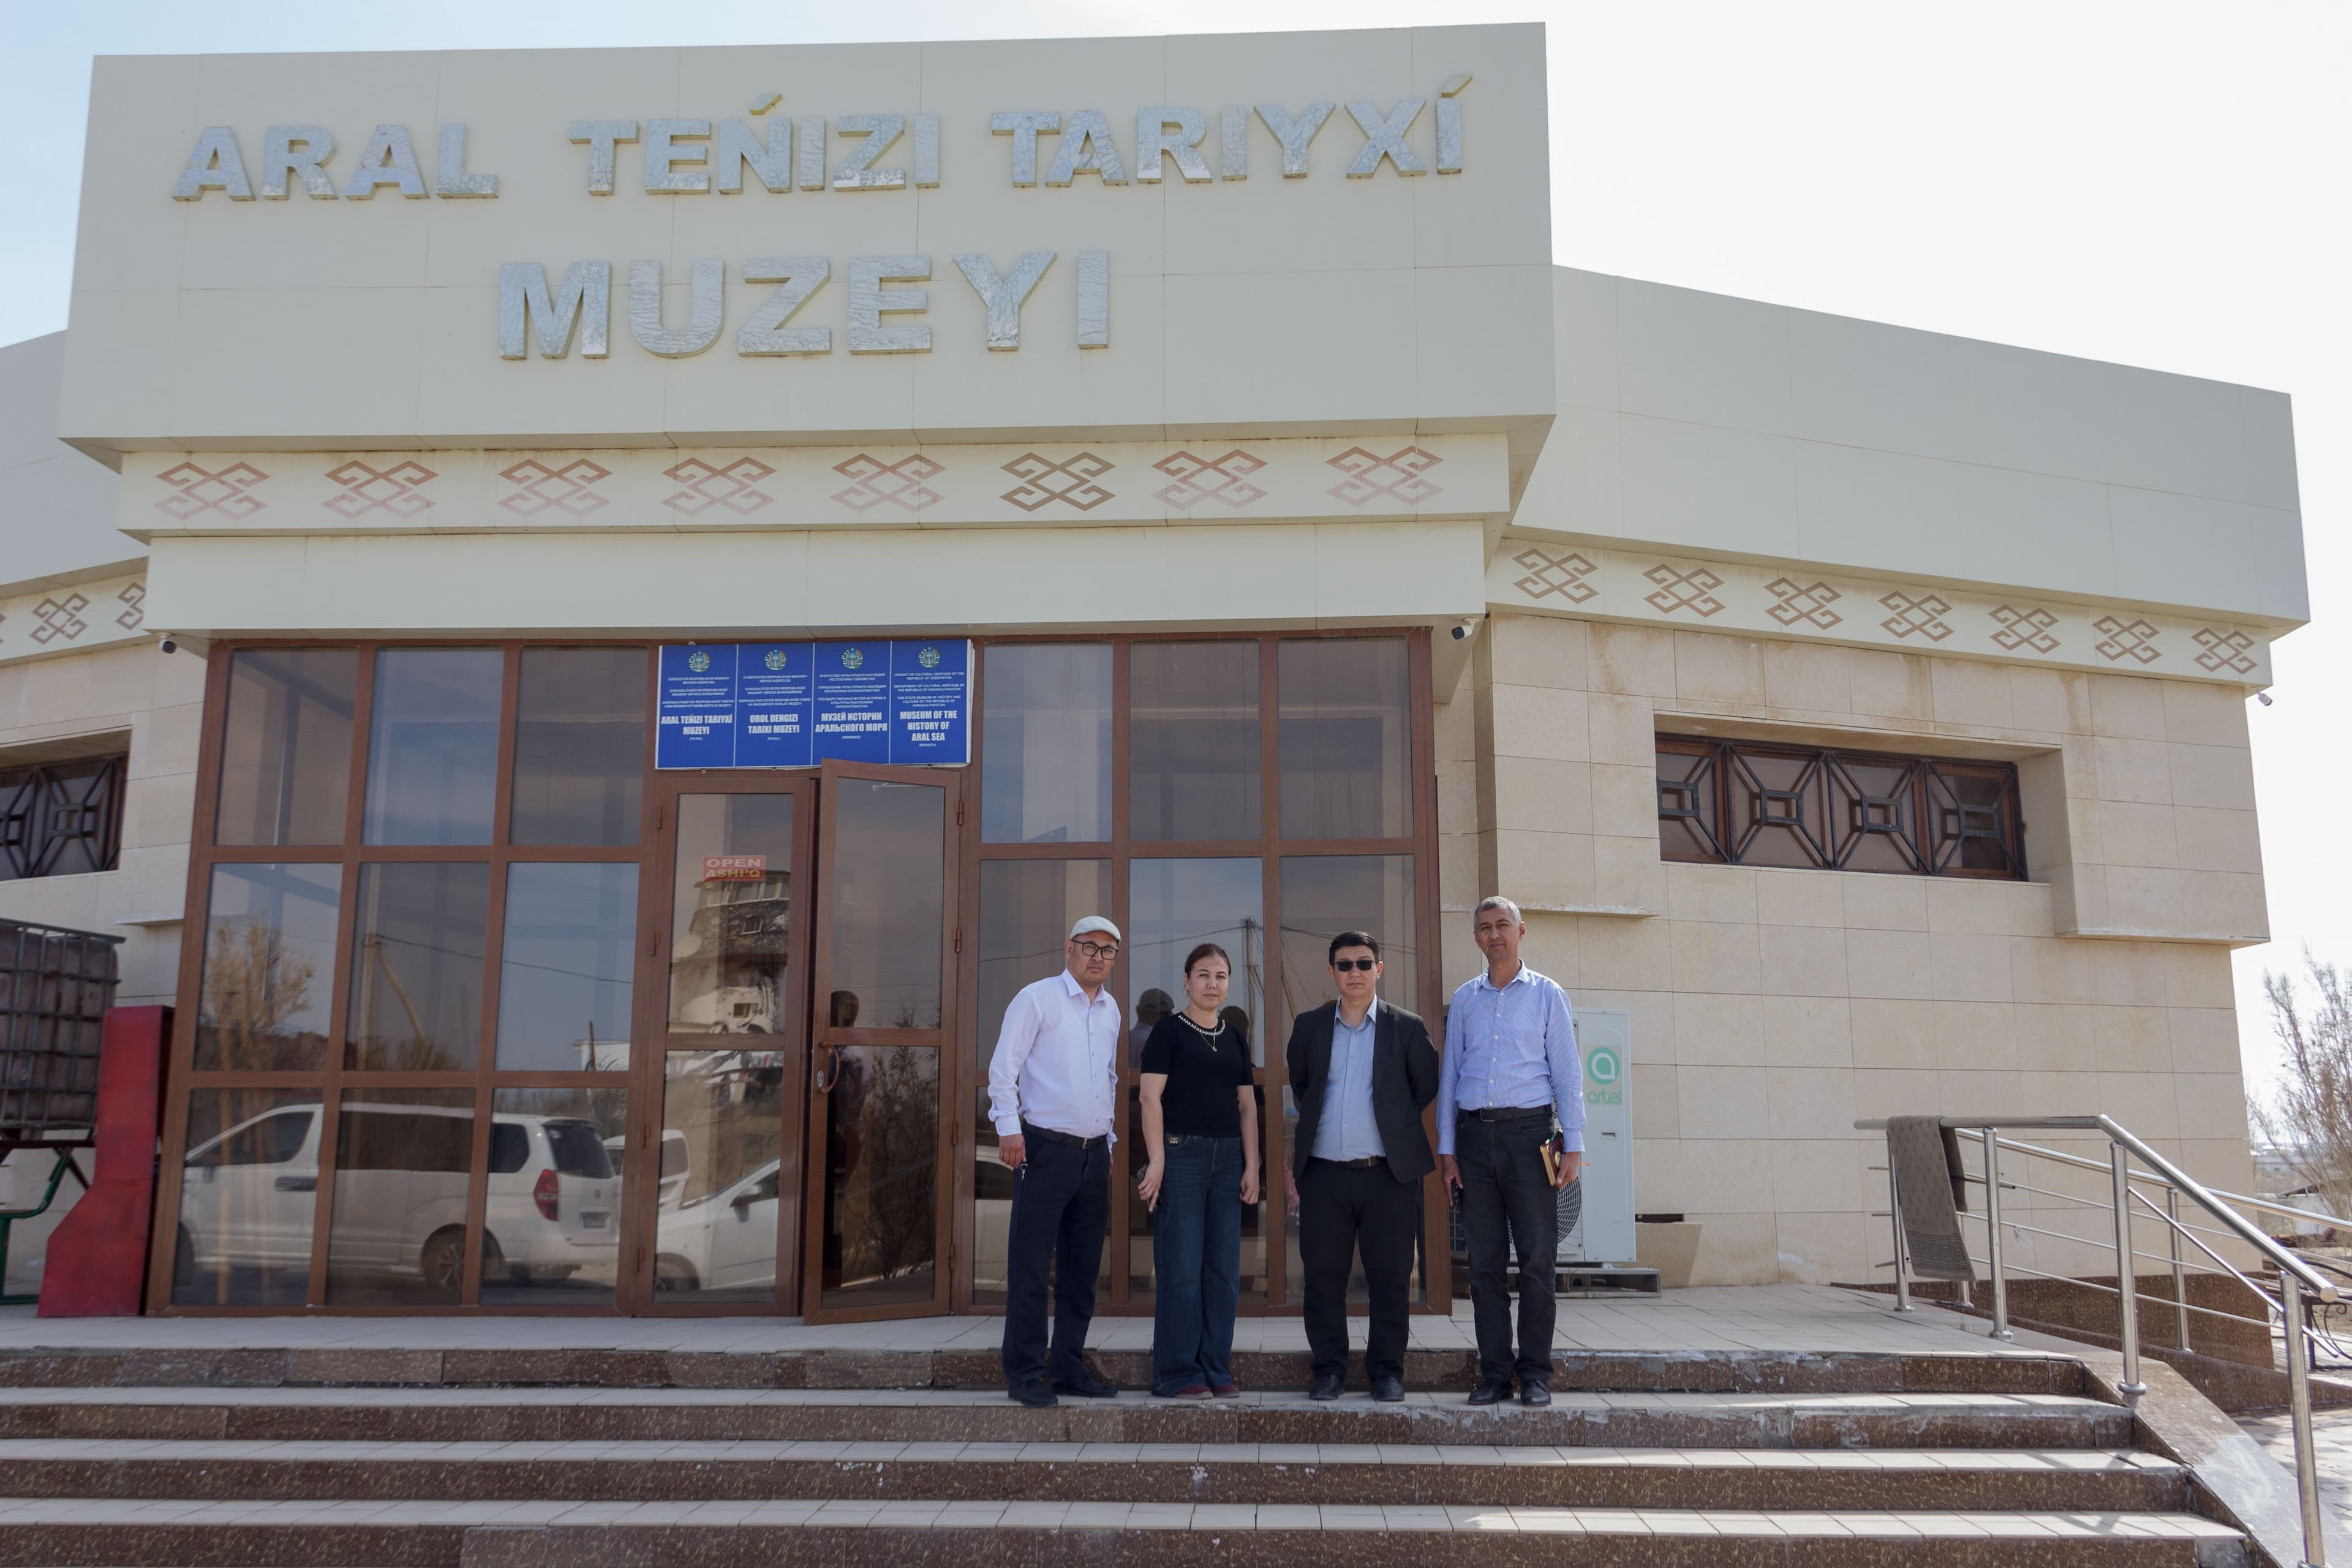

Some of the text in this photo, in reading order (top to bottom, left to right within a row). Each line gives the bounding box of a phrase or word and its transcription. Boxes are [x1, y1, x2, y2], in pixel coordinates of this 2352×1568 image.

[172, 74, 1473, 202] ARAL TEŃIZI TARIYXÍ
[499, 251, 1109, 360] MUZEYI
[750, 714, 799, 723] OROL DENGIZI
[821, 712, 882, 722] МУЗЕЙ ИСТОРИИ
[900, 711, 932, 720] MUSEUM
[933, 710, 943, 719] OF
[683, 726, 710, 735] MUZEYI
[747, 725, 800, 734] TARIXI MUZEYI
[815, 723, 888, 733] АРАЛЬСКОГО МОРЯ
[908, 722, 939, 730] HISTORY
[911, 733, 930, 741] ARAL
[706, 858, 761, 868] OPEN
[1587, 1088, 1622, 1104] artel
